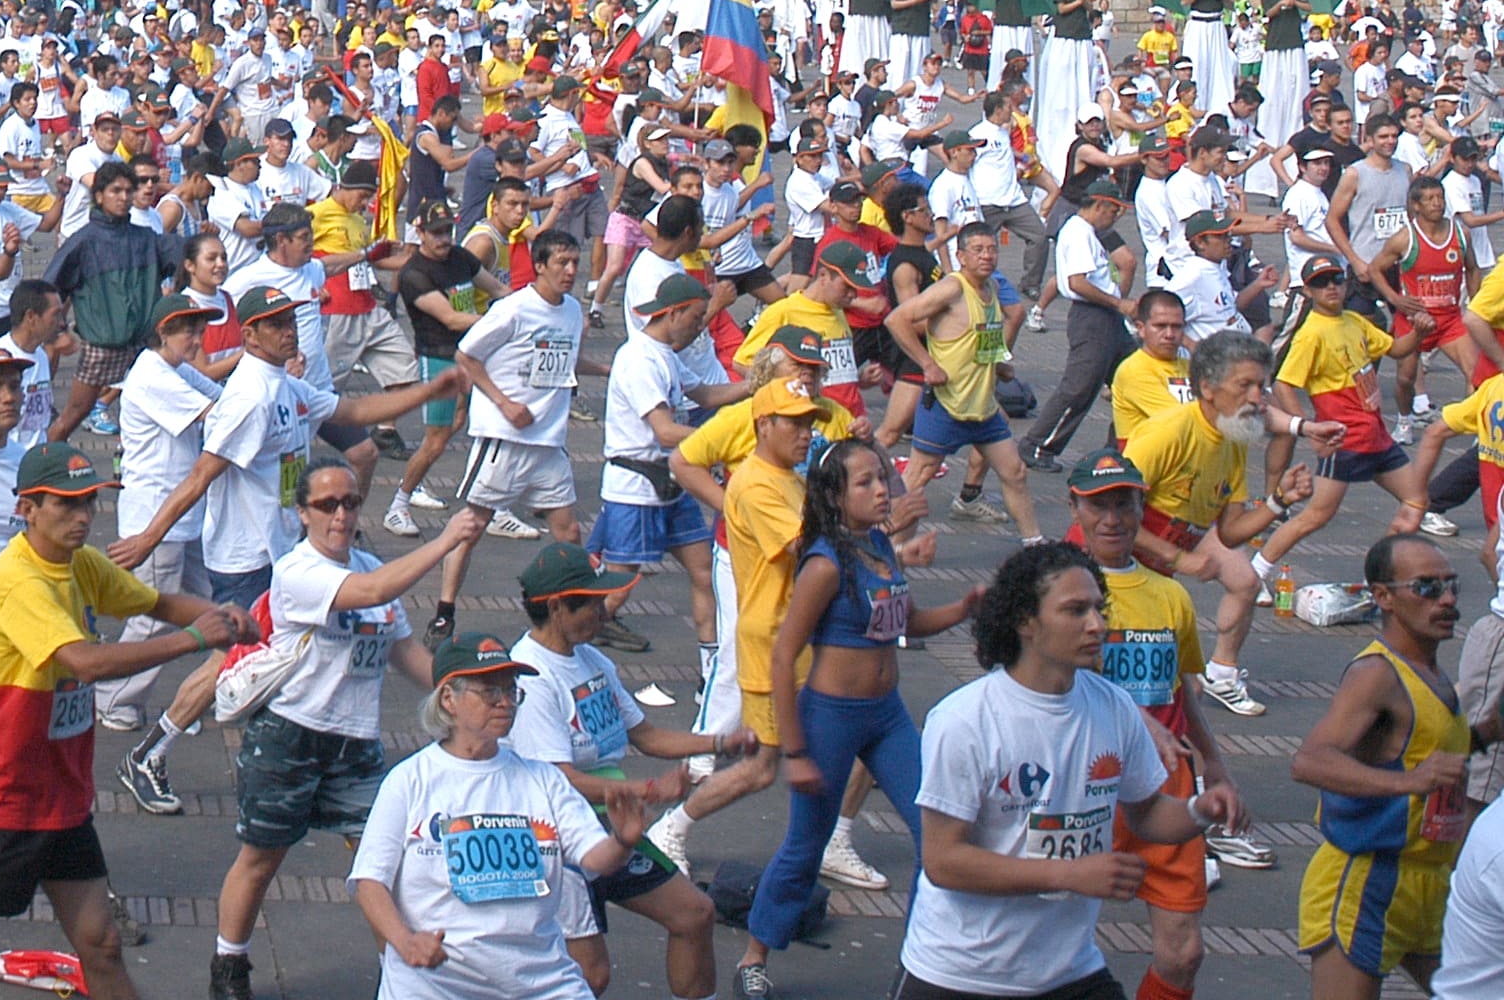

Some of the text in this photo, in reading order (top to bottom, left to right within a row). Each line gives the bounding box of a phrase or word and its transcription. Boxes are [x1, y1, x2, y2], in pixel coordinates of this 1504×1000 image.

[1378, 214, 1404, 228] 6774
[538, 351, 569, 373] 2017
[823, 350, 853, 370] 2784
[1125, 629, 1175, 642] Porvenir
[1102, 647, 1176, 682] 46898
[472, 815, 528, 829] Porvenir
[447, 833, 539, 875] 50038
[539, 845, 560, 857] enir
[512, 870, 538, 880] 2006
